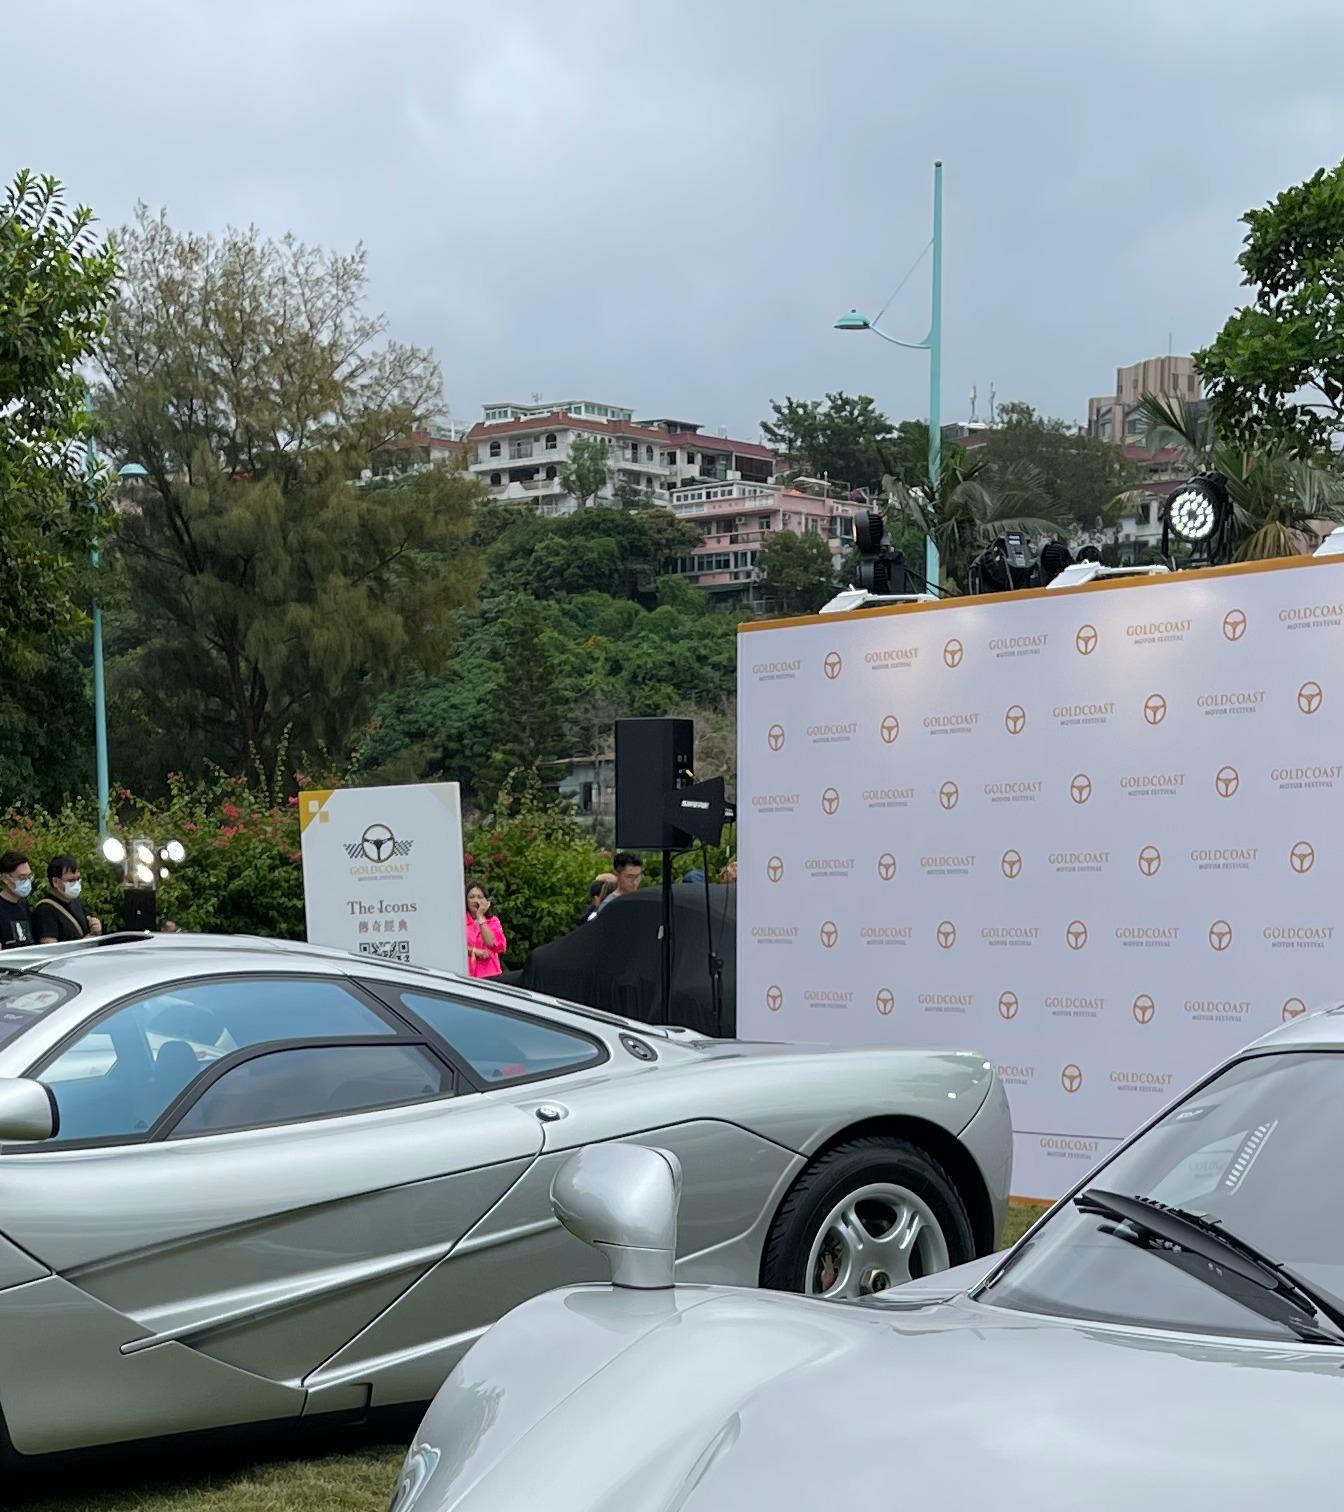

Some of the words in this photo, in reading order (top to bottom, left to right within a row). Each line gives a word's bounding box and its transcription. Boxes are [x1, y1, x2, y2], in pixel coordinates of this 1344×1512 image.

[1126, 619, 1193, 637] GOLDCOAST
[989, 633, 1048, 651] GOLDCOAST
[865, 647, 919, 663] GOLDCOAST
[1197, 691, 1266, 707] GOLDCOAST
[1053, 702, 1115, 718] GOLDCOAST
[923, 713, 980, 728] GOLDCOAST
[1270, 765, 1343, 781] GOLDCOAST
[984, 781, 1043, 795] GOLDCOAST
[1120, 774, 1185, 788] GOLDCOAST
[862, 788, 915, 801] GOLDCOAST
[920, 855, 976, 867] GOLDCOAST
[1048, 852, 1110, 864] GOLDCOAST
[1190, 848, 1259, 861] GOLDCOAST
[347, 901, 375, 915] The
[379, 900, 417, 913] Icons
[860, 927, 913, 937] GOLDCOAST
[981, 927, 1040, 938] GOLDCOAST
[1115, 927, 1179, 938] GOLDCOAST
[1263, 927, 1334, 939] GOLDCOAST
[918, 994, 973, 1005] GOLDCOAST
[1045, 997, 1105, 1009] GOLDCOAST
[1184, 1000, 1251, 1013] GOLDCOAST
[998, 1065, 1035, 1079] DCOAST
[1109, 1071, 1173, 1085] GOLDCOAST
[1039, 1137, 1100, 1152] GOLDCOAST
